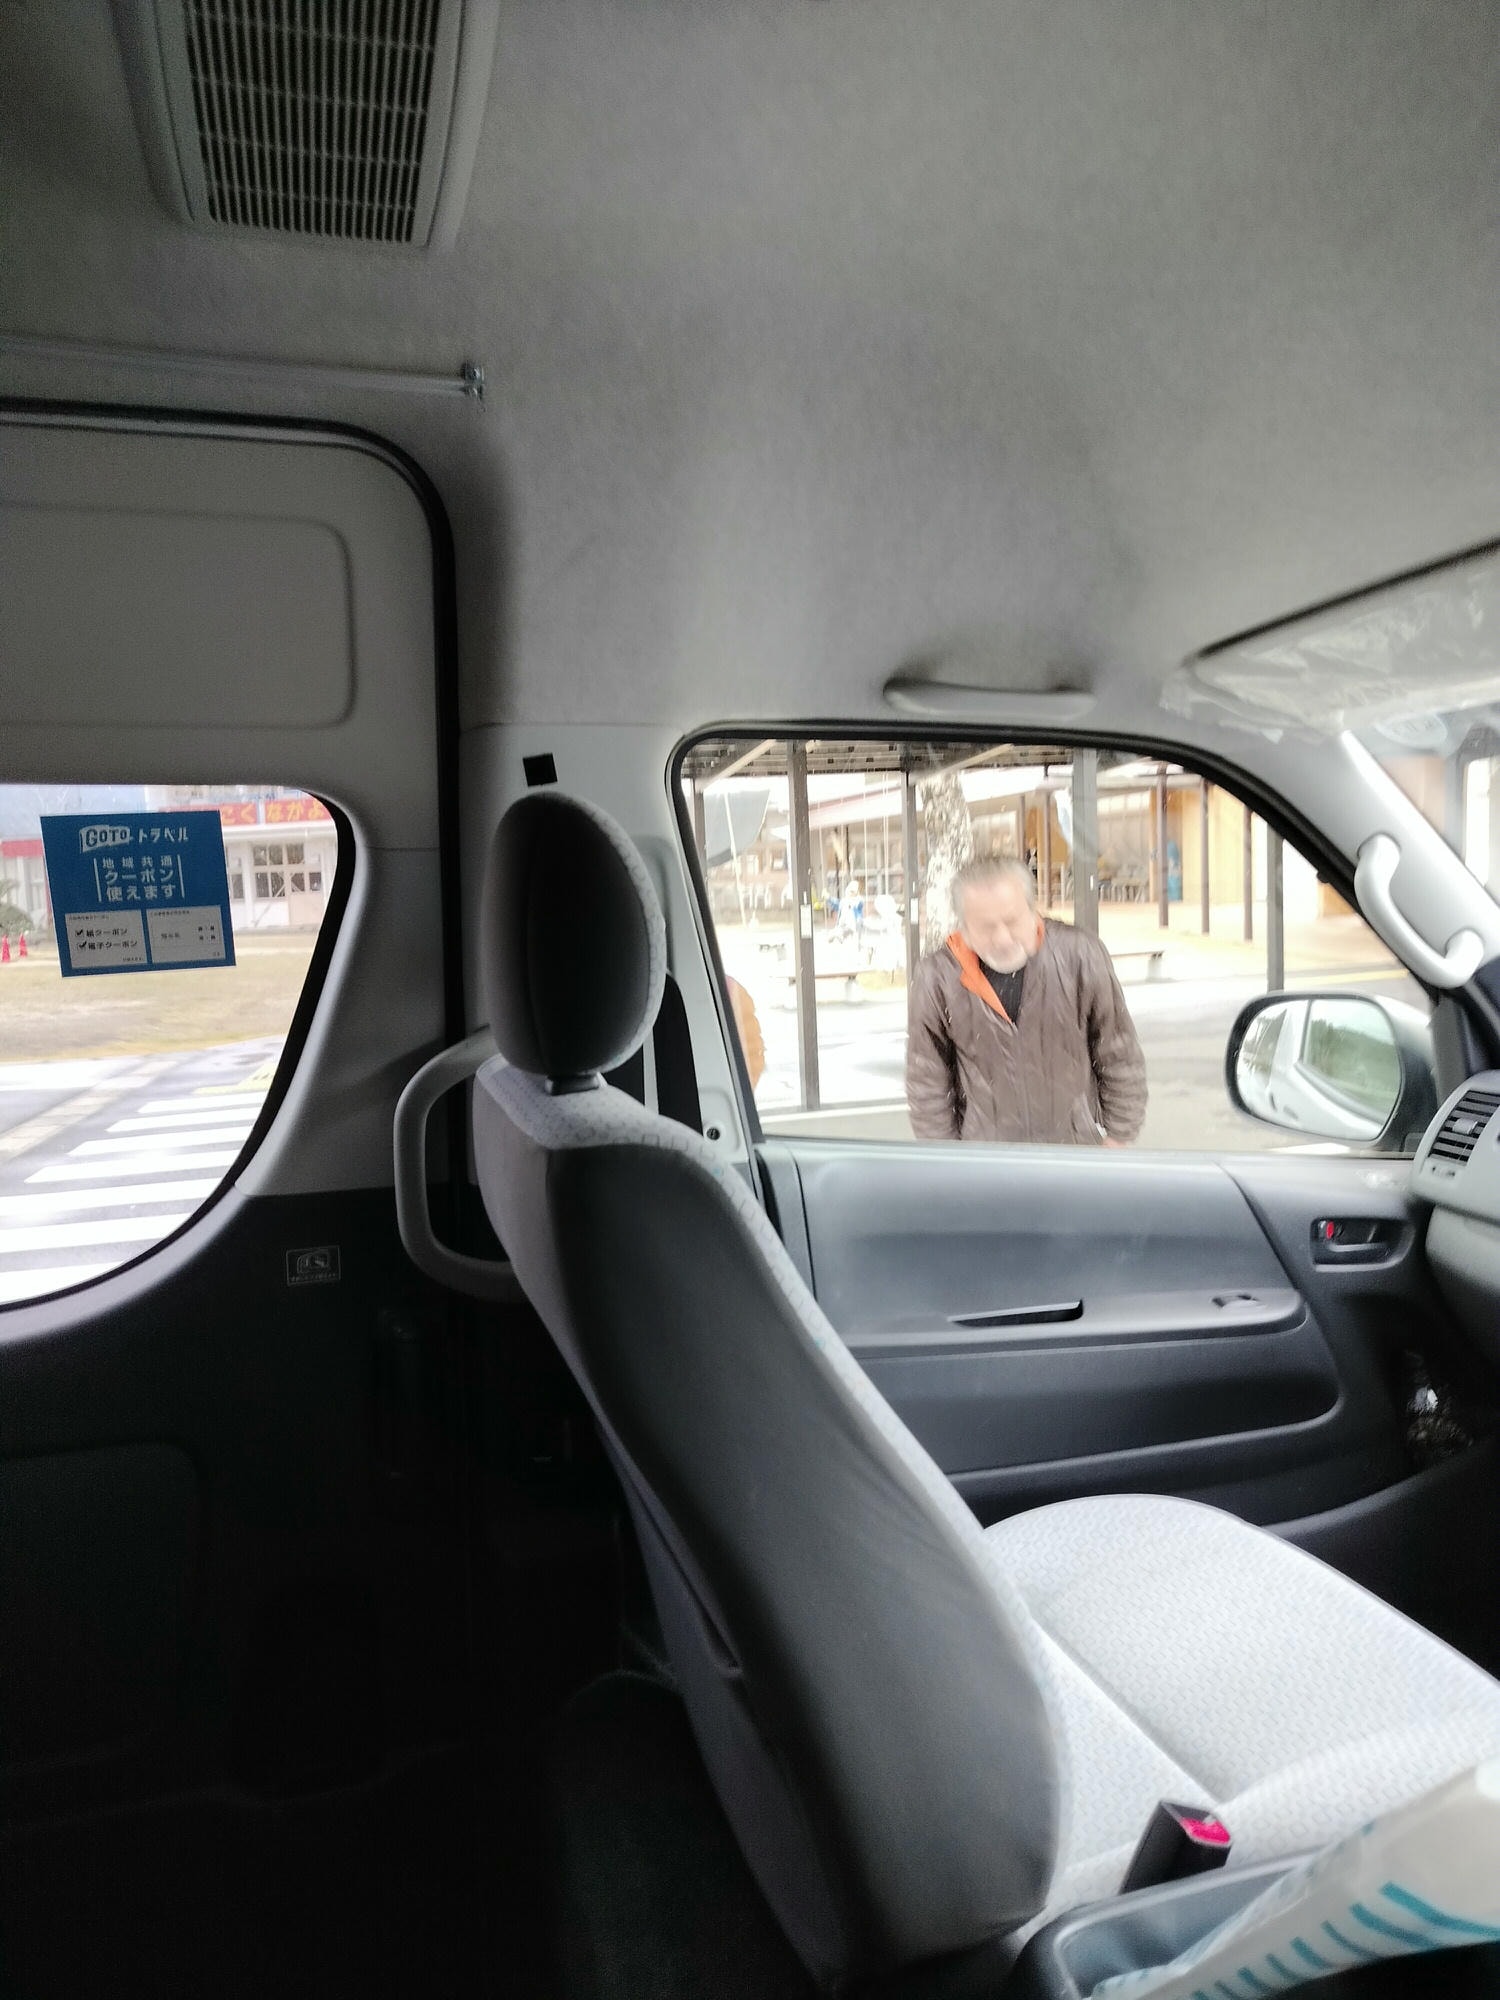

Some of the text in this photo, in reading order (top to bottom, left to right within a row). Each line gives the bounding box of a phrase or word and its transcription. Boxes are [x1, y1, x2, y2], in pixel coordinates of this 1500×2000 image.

[139, 827, 189, 843] トラベル
[102, 855, 172, 869] 地域共通
[105, 869, 174, 884] クーポン
[106, 884, 176, 902] 使えます
